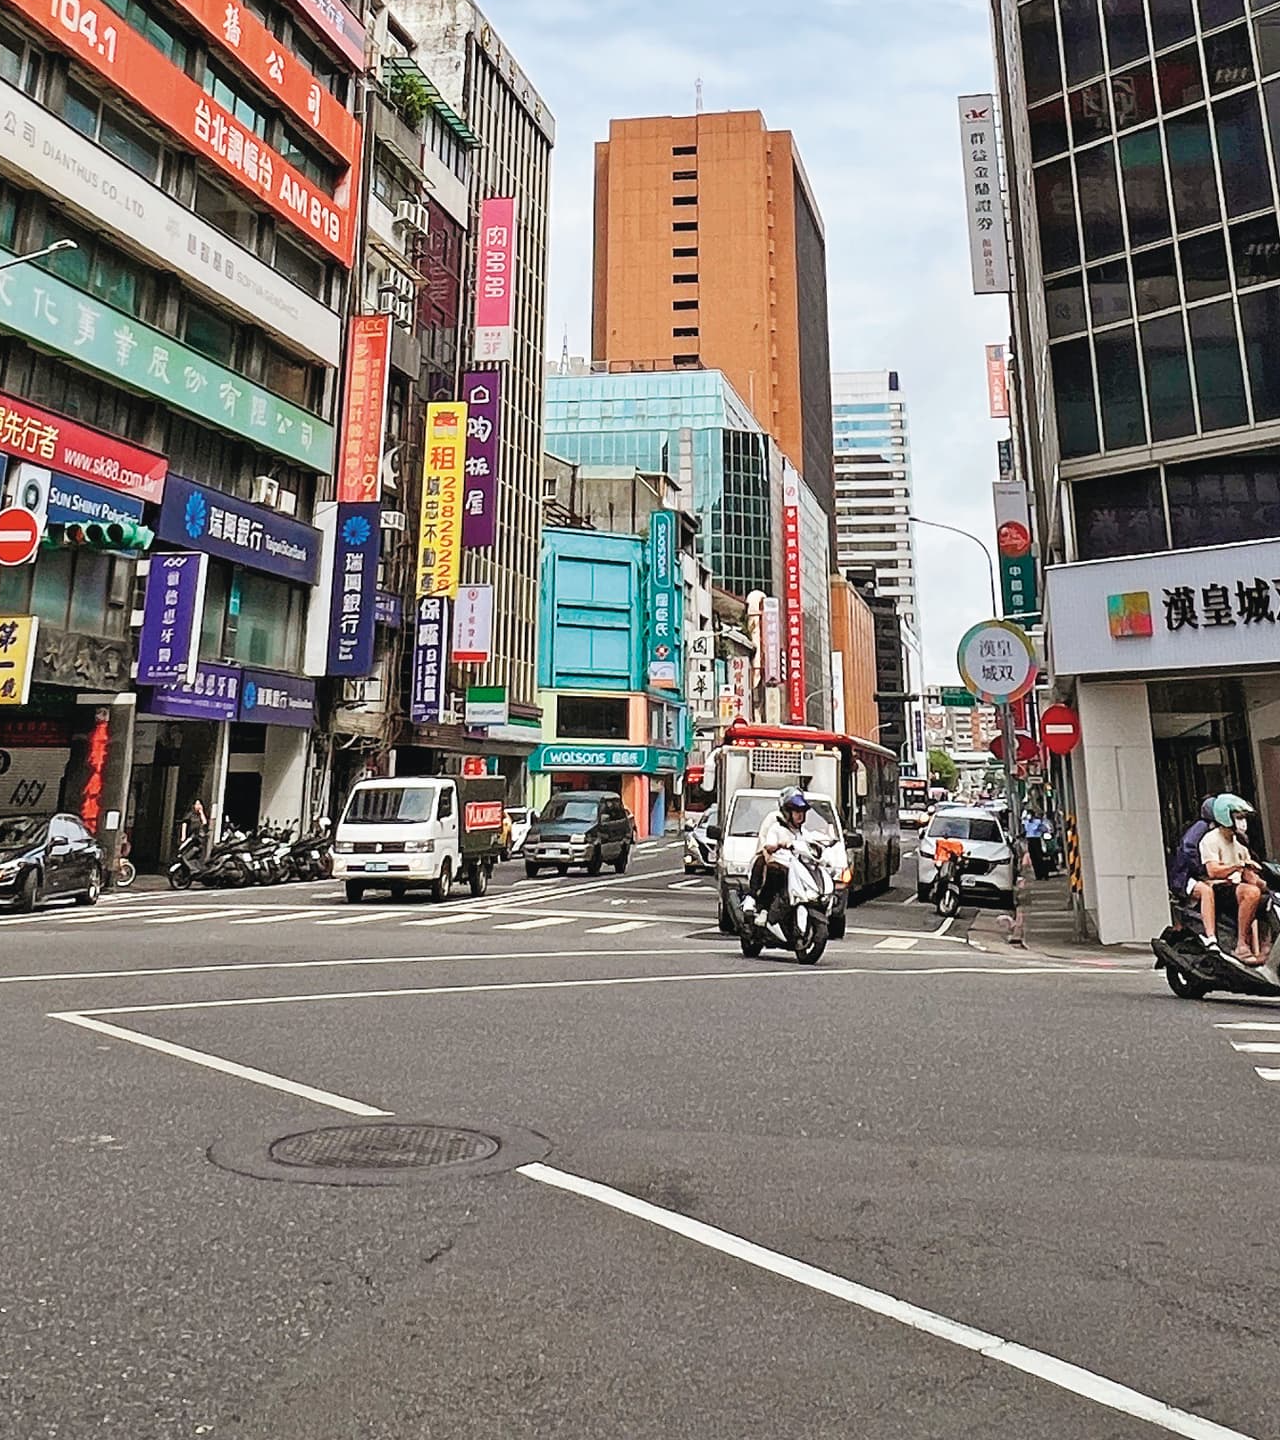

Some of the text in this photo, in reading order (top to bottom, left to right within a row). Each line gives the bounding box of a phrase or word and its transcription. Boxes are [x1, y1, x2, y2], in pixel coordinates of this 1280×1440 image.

[193, 98, 341, 243] 台北調幅台 AM 819
[430, 445, 456, 470] 租
[549, 751, 607, 765] watsons
